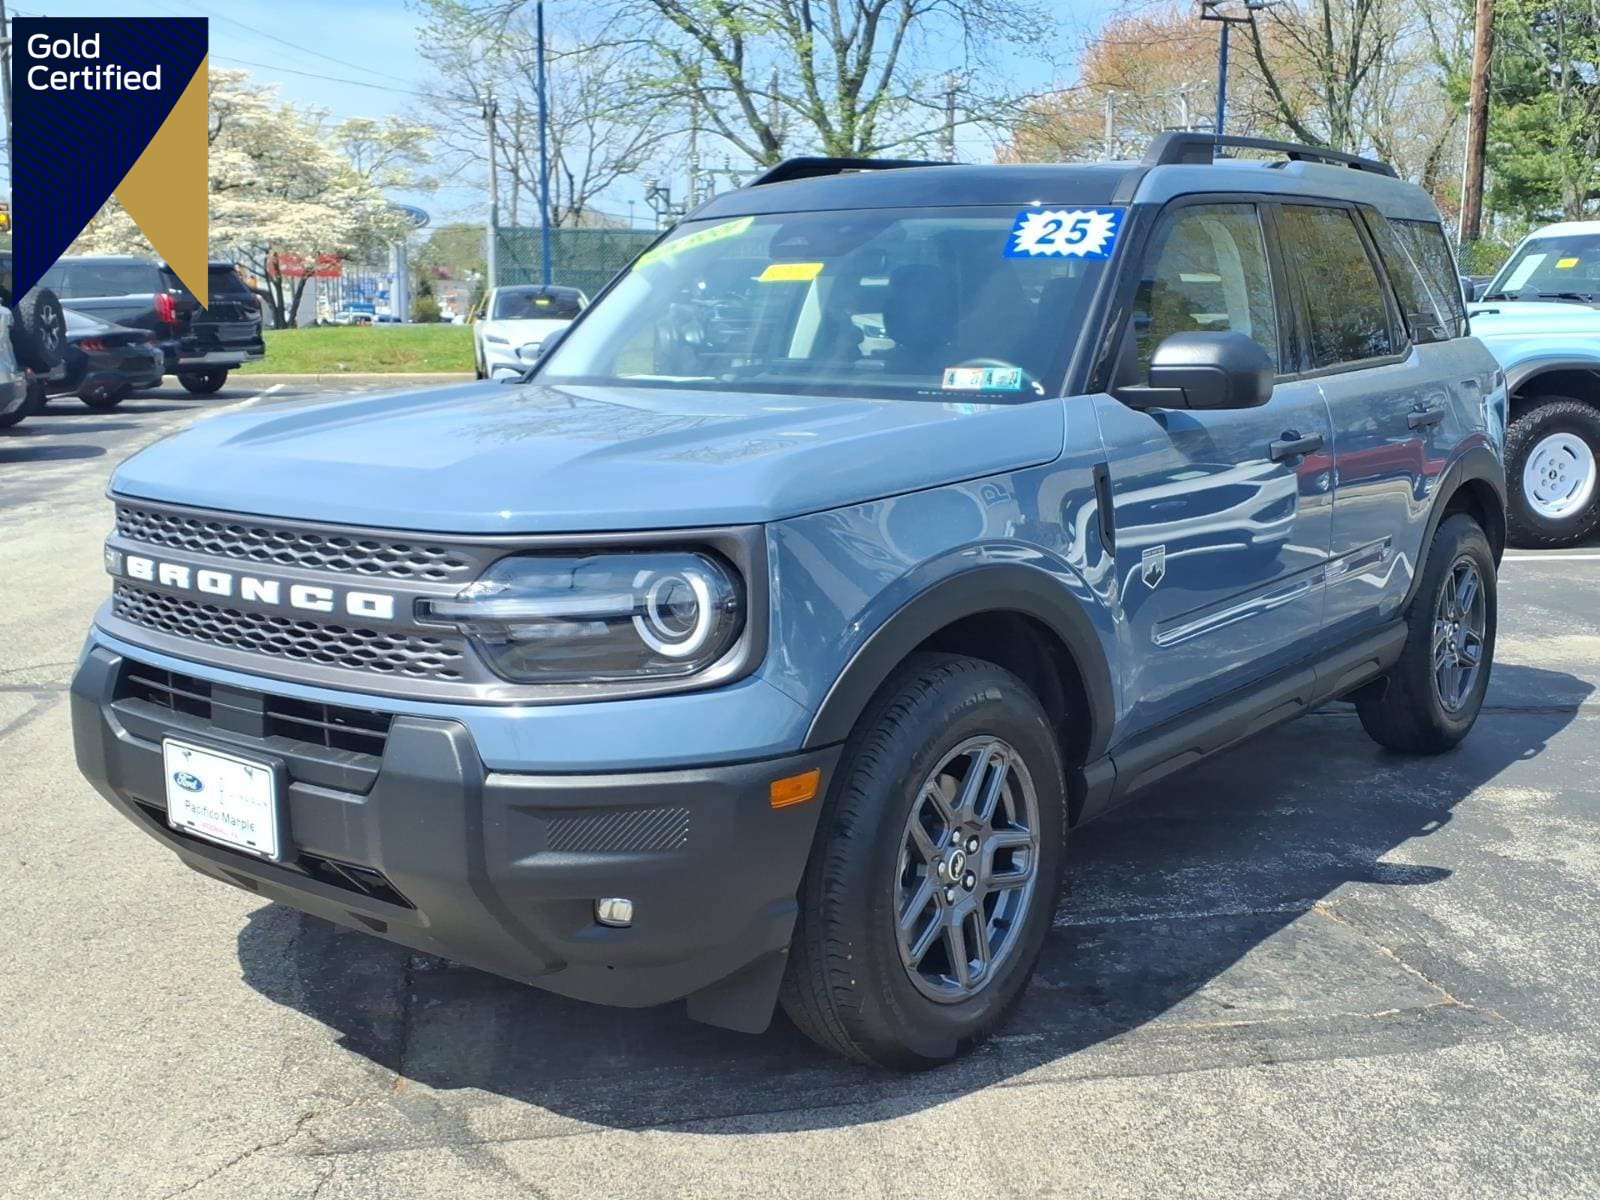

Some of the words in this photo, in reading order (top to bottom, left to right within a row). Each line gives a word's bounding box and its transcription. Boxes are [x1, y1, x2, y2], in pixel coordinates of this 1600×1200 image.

[1035, 219, 1091, 245] 25
[126, 555, 394, 620] BRONCO
[175, 772, 202, 791] Ford
[184, 799, 220, 821] Pacifico
[221, 811, 256, 832] Marple
